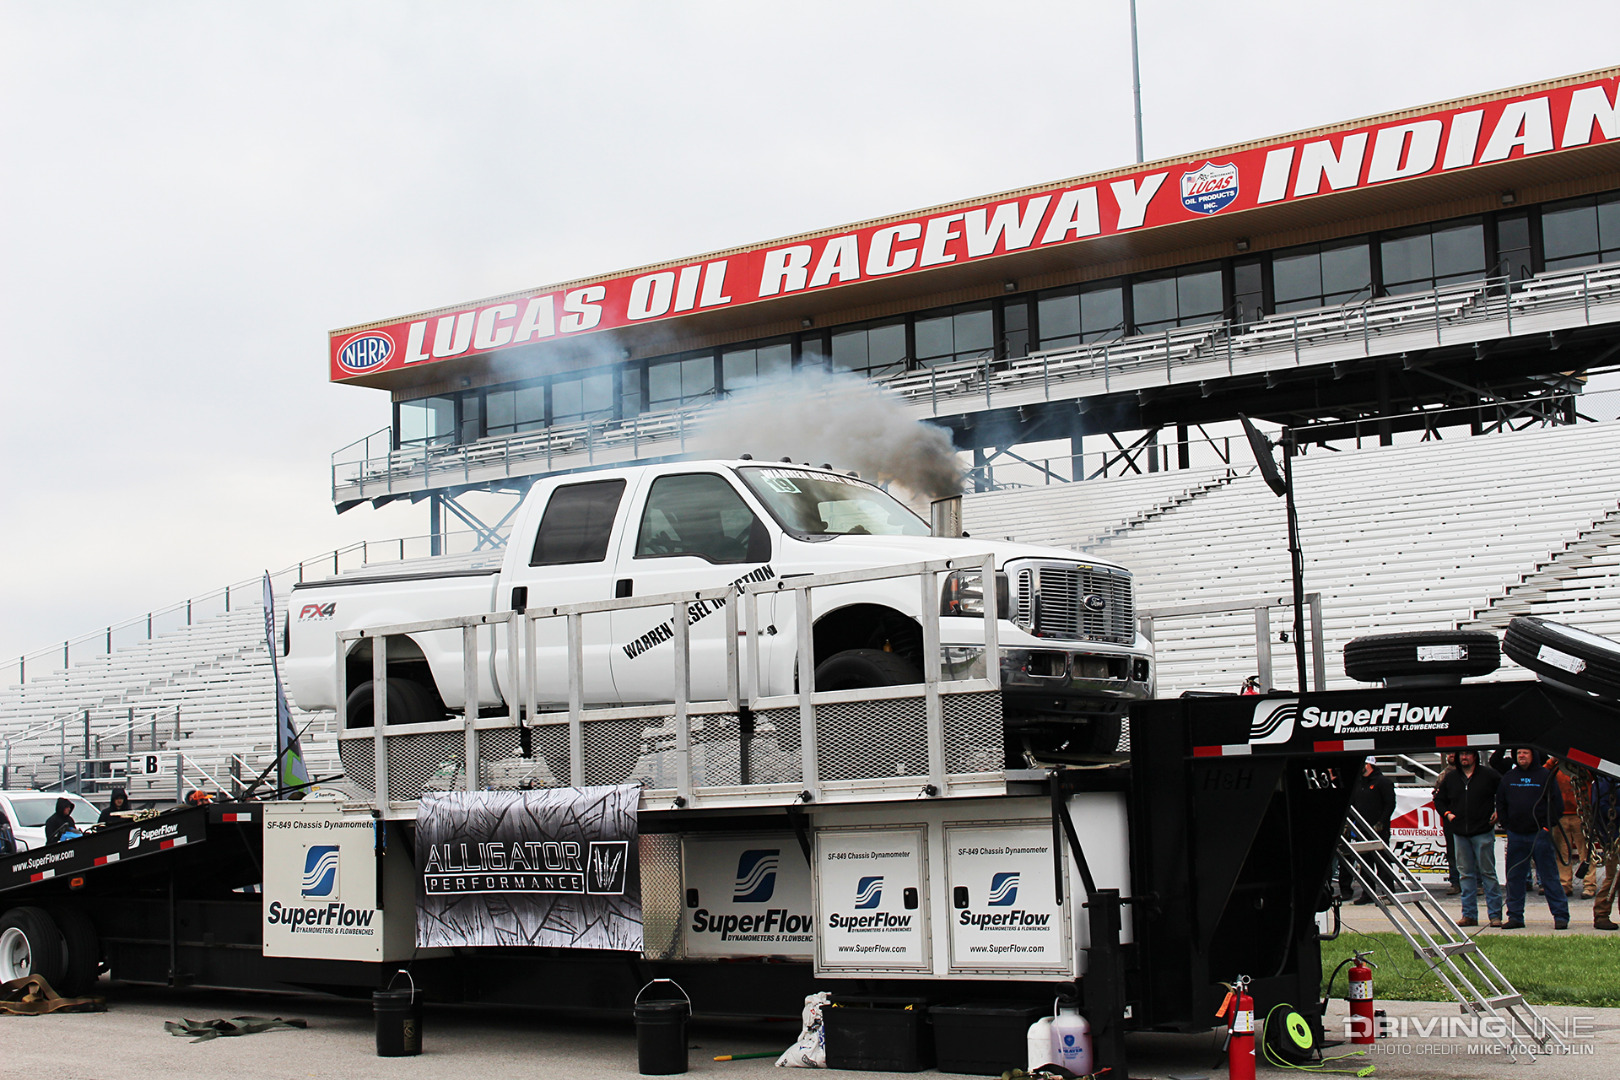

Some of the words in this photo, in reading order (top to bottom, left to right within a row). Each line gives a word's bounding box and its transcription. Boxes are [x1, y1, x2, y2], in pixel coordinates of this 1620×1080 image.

[1187, 175, 1234, 196] LUCAS
[1185, 197, 1198, 205] OIL
[1198, 190, 1236, 203] PRODUCTS
[1203, 202, 1219, 210] INC.
[404, 285, 606, 364] LUCAS
[627, 259, 733, 321] OIL
[758, 171, 1170, 298] RACEWAY
[346, 338, 387, 367] NHRA
[299, 602, 337, 619] FX4
[622, 621, 674, 660] WARREN
[1300, 703, 1450, 734] SuperFlow
[1341, 725, 1394, 734] DYNAMOMETERS
[1402, 723, 1450, 731] FLOWBENCHES
[146, 755, 158, 774] B
[141, 824, 179, 840] SuperFlow
[266, 820, 292, 829] SF-849
[293, 820, 322, 829] Chassis
[324, 820, 374, 830] Dynamomete
[1398, 829, 1437, 837] CONVERSION
[425, 841, 583, 872] ALLIGATOR
[828, 852, 846, 860] SF-849
[848, 852, 870, 860] Chassis
[871, 851, 910, 860] Dynamometer
[958, 848, 979, 856] SF-849
[979, 847, 1004, 855] Chassis
[1005, 846, 1048, 856] Dynamometer
[12, 850, 75, 873] www.SuperFlow.com
[430, 877, 579, 891] PERFORMANCE
[267, 901, 375, 933] SuperFlow
[829, 912, 911, 933] SuperFlow
[959, 909, 1050, 931] SuperFlow
[296, 926, 334, 935] DYNAMOMETERS
[335, 927, 339, 935] &
[340, 927, 374, 936] FLOWBENCHES
[728, 934, 775, 942] DYNAMOMETERS
[838, 944, 907, 954] www.SuperFlow.com
[969, 944, 1045, 954] www.SuperFlow.com
